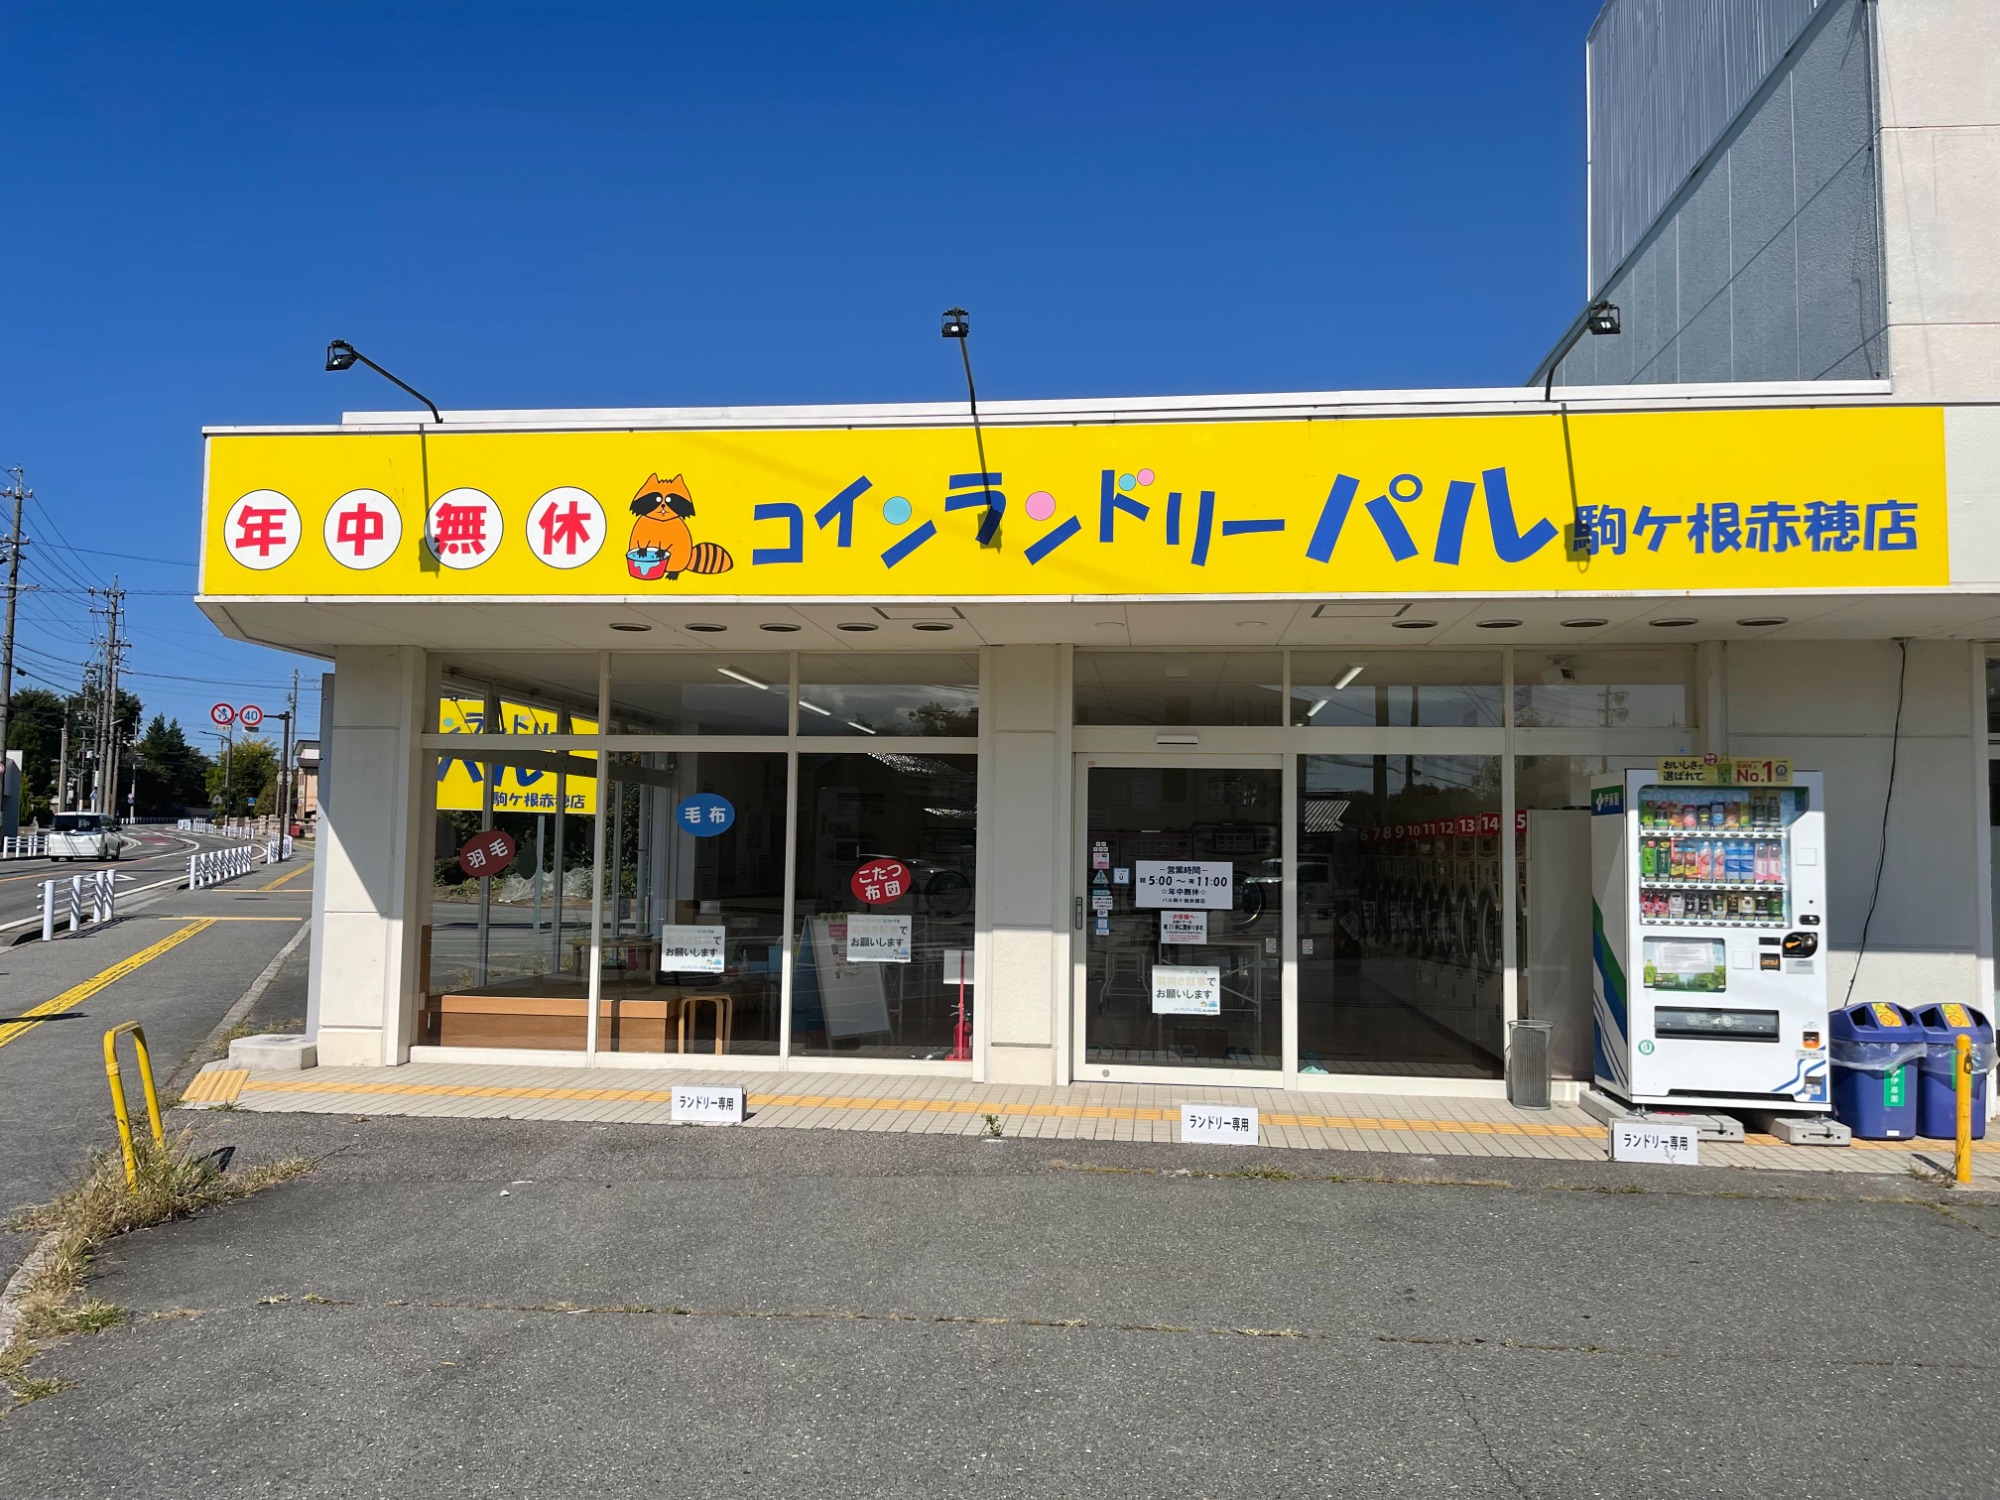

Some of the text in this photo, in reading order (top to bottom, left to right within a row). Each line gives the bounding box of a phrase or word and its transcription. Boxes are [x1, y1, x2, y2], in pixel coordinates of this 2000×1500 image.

[752, 467, 1286, 569] コインランドリー
[1305, 466, 1559, 566] パル
[235, 500, 592, 557] 年中無休
[244, 710, 258, 721] 40
[1663, 760, 1704, 770] おいしさで
[1737, 761, 1772, 783] No.1
[684, 806, 726, 824] 毛布
[1407, 825, 1420, 836] 10
[1423, 823, 1436, 835] 11
[1439, 822, 1454, 834] 12
[1459, 819, 1475, 832] 13
[1481, 816, 1499, 831] 14
[466, 838, 508, 869] 羽毛
[858, 864, 902, 884] こたつ
[865, 881, 901, 900] 布団
[851, 937, 904, 947] お願いします
[665, 947, 718, 957] お願いします
[1156, 989, 1213, 999] お願いします
[679, 1096, 734, 1111] ランドリー専用
[1189, 1115, 1249, 1132] ランドリー専用
[1623, 1133, 1688, 1151] ランドリー専用
